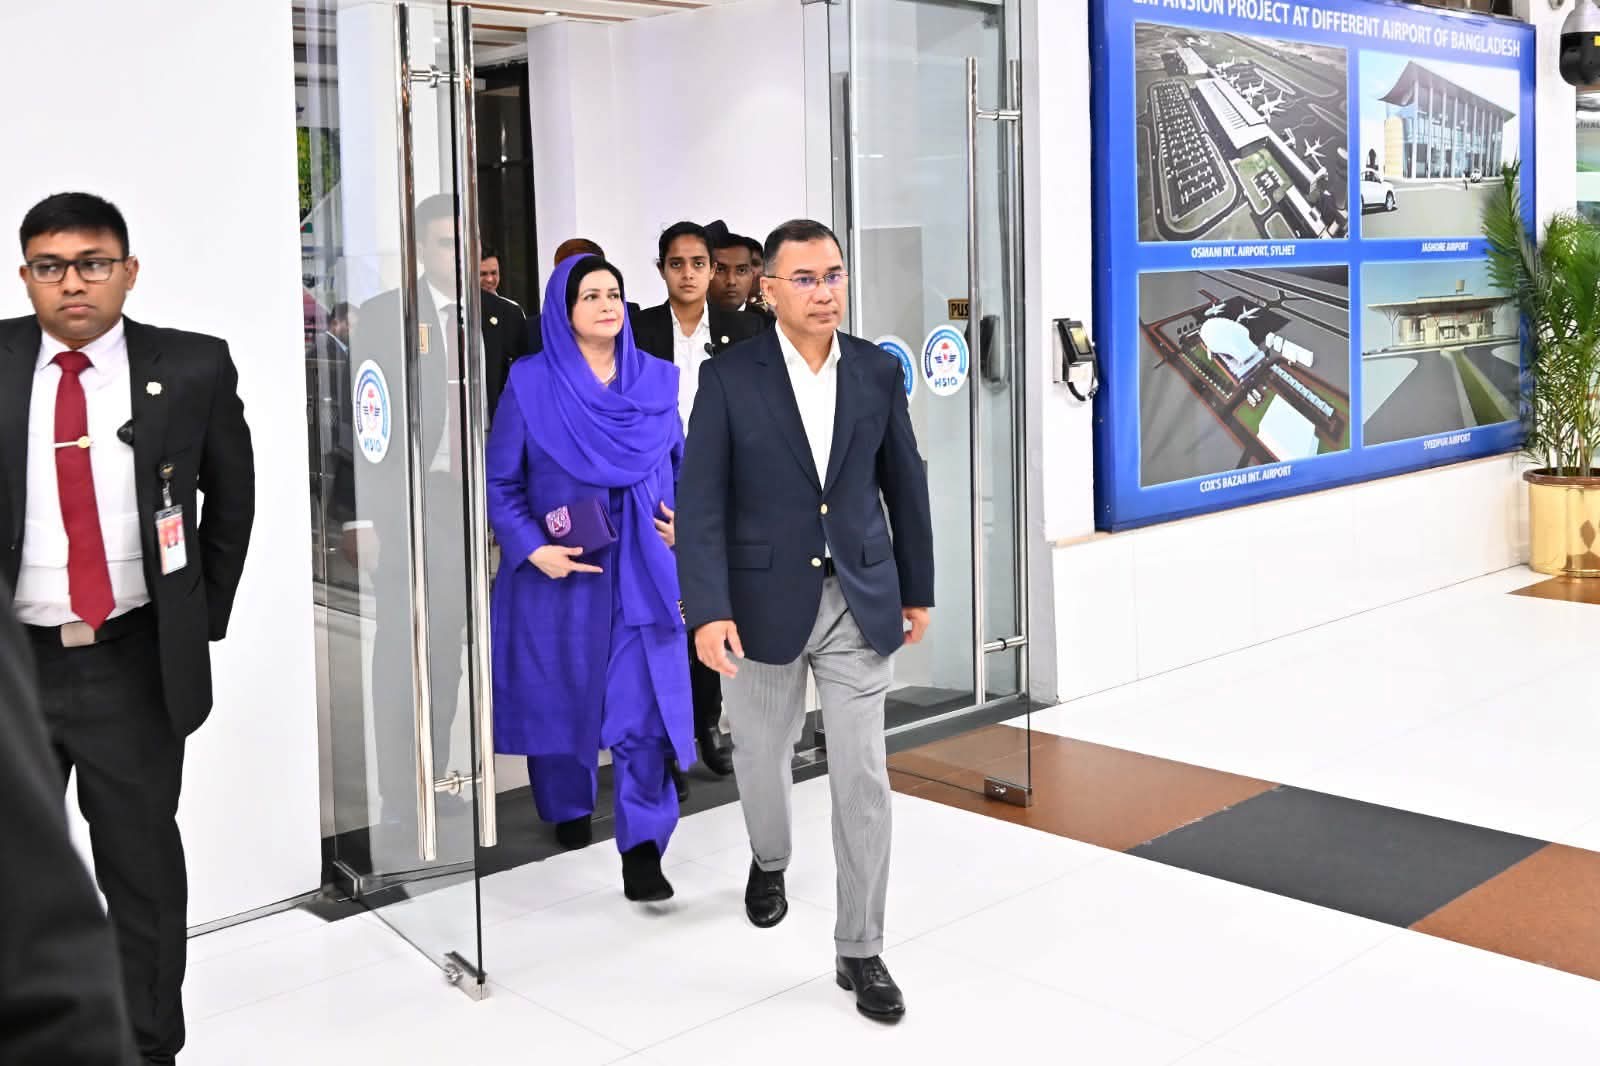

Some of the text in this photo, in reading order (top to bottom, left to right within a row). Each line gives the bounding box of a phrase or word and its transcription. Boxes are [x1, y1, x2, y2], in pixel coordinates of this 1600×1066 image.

[1228, 0, 1290, 24] PROJECT
[1292, 5, 1309, 26] AT
[1312, 9, 1381, 37] DIFFERENT
[1383, 25, 1432, 43] AIRPORT
[1434, 31, 1449, 47] OF
[1451, 32, 1520, 57] BANGLADESH
[1192, 246, 1222, 258] OSMANI
[1223, 246, 1237, 257] INT.
[1270, 245, 1296, 256] SYLHET
[951, 303, 969, 316] PUS
[1200, 478, 1221, 493] COX'S
[1222, 473, 1247, 488] BAZAR
[1262, 465, 1291, 480] AIRPORT
